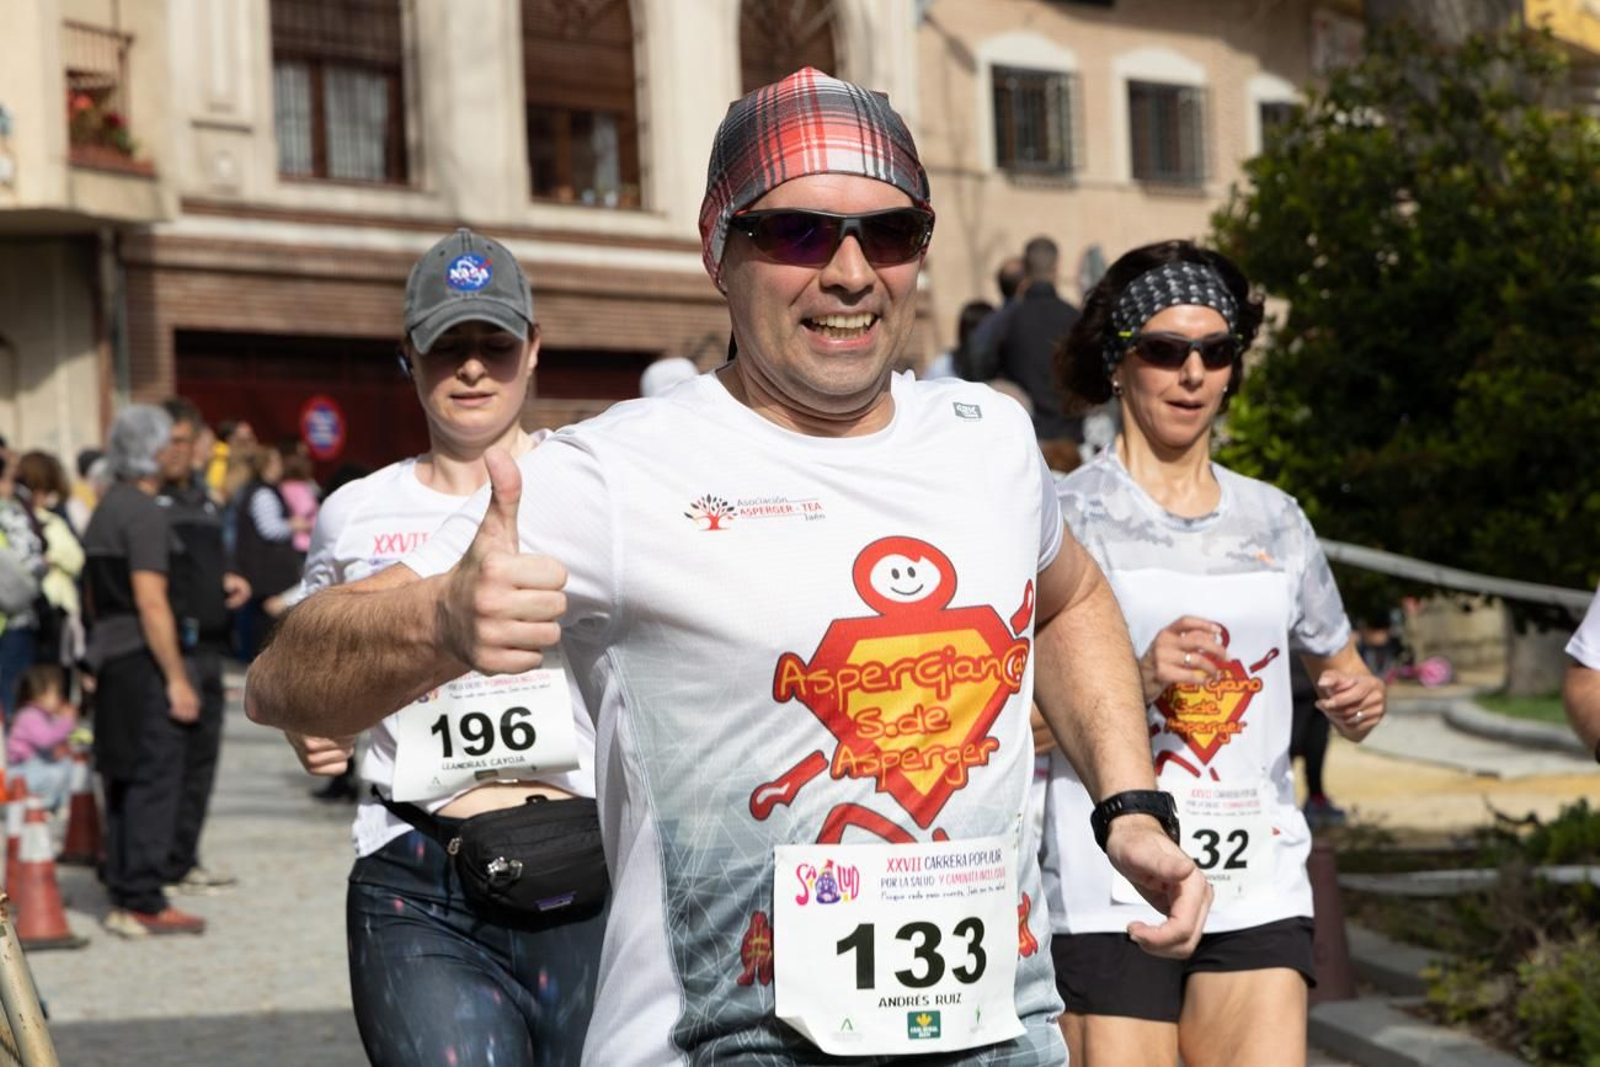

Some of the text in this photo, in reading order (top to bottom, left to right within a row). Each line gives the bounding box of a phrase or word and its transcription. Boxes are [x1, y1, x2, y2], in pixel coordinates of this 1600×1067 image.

[449, 267, 489, 281] NASA
[740, 504, 793, 516] ASPERGER
[802, 502, 822, 512] TEA
[431, 706, 536, 758] 196
[832, 737, 1000, 788] Asperger
[887, 848, 1003, 873] XXVII CARRERA POPULAR
[1192, 829, 1249, 870] 32
[881, 877, 897, 888] POR
[899, 877, 909, 887] LA
[910, 875, 935, 887] SALUD
[939, 874, 945, 886] Y
[837, 916, 987, 990] 133
[878, 992, 962, 1008] ANDRÉS RUIZ
